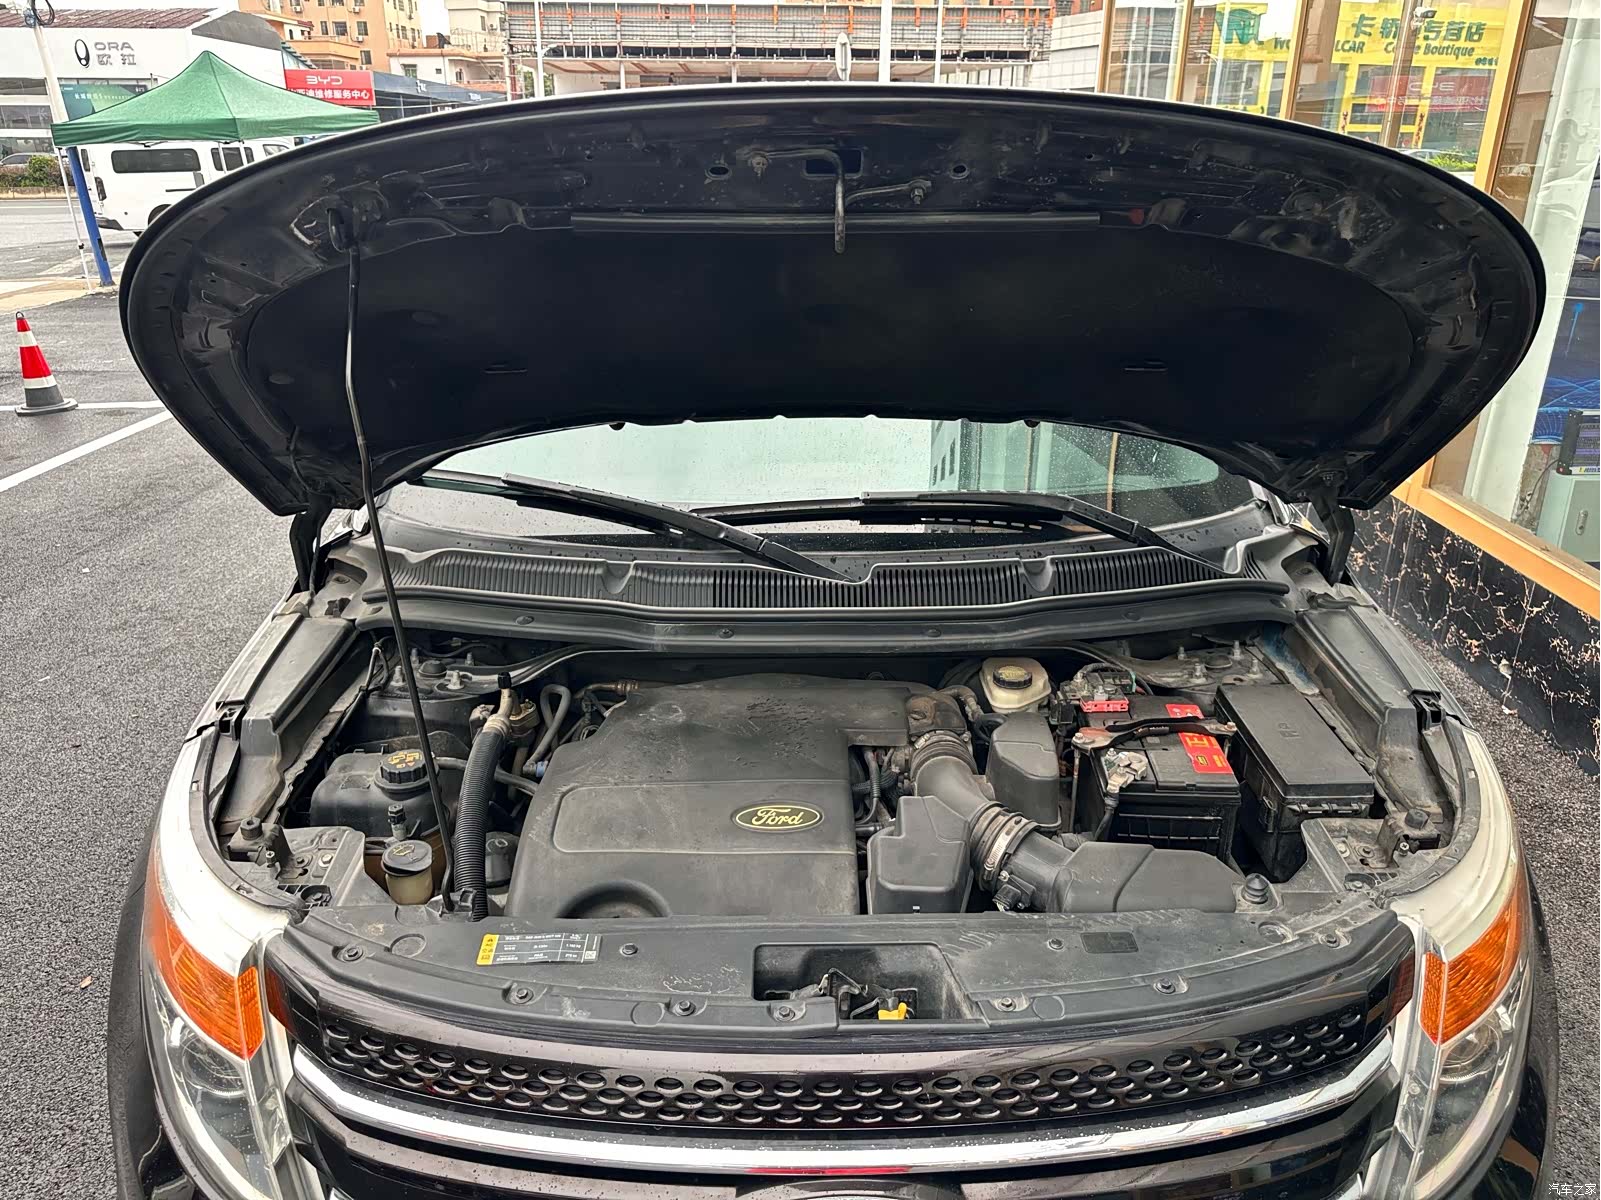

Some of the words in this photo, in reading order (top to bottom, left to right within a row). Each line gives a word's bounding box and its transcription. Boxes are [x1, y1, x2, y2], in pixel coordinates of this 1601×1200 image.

[94, 42, 135, 51] ORA
[1423, 42, 1475, 60] Boutique
[305, 75, 343, 85] BYD
[751, 808, 804, 825] Ford
